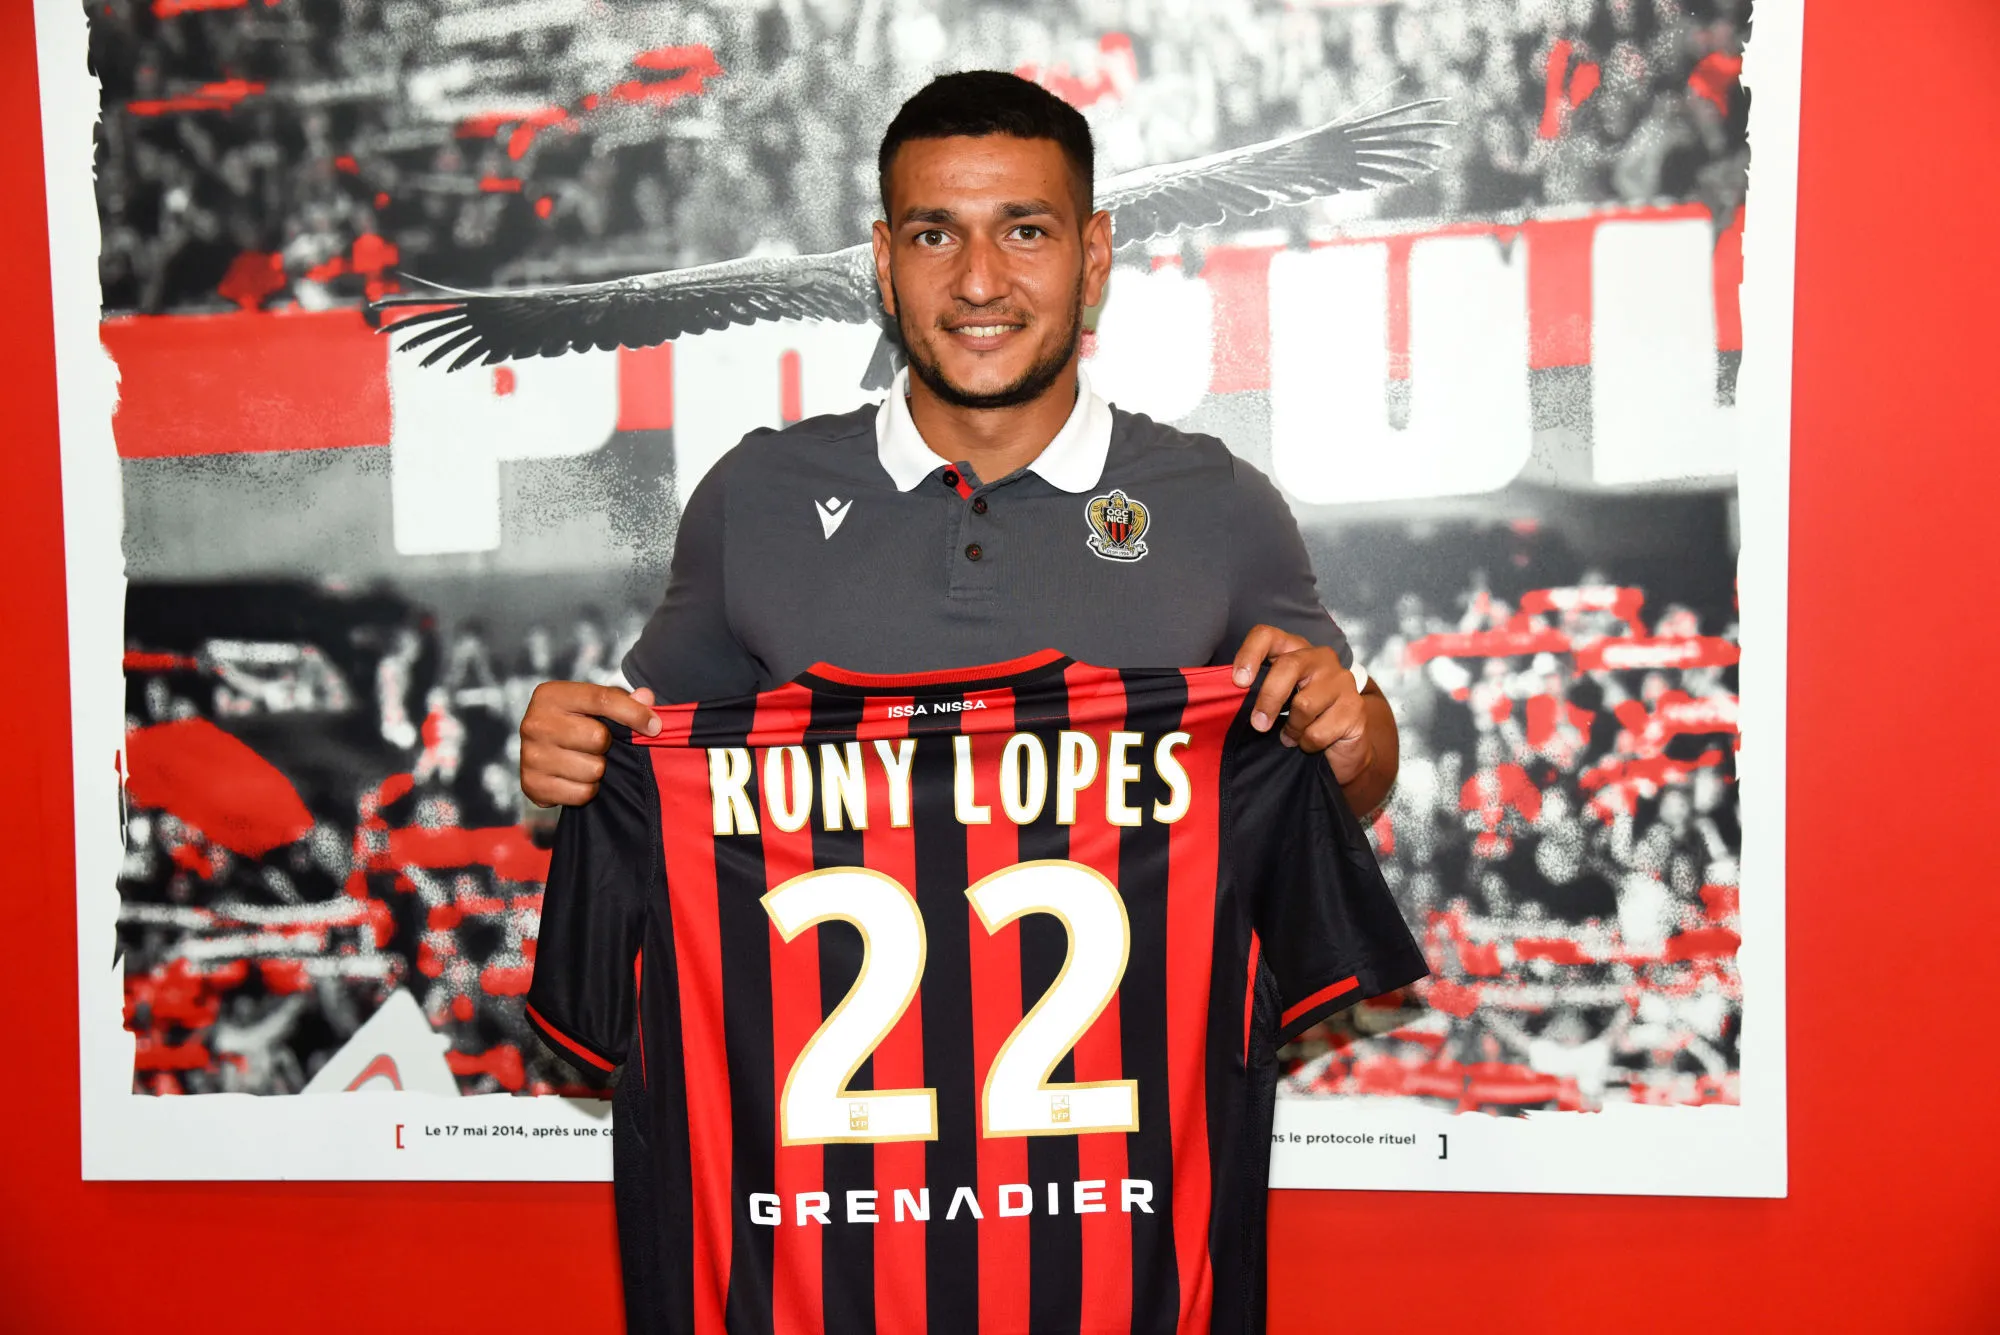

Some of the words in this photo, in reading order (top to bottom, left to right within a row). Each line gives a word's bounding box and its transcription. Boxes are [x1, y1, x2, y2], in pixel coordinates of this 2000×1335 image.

[1106, 508, 1129, 517] OGC
[1106, 516, 1129, 525] NICE
[888, 704, 928, 718] ISSA
[933, 699, 988, 714] NISSA
[707, 738, 918, 836] RONY
[952, 730, 1193, 827] LOPES
[759, 858, 1140, 1147] 22
[425, 1125, 442, 1136] Le
[445, 1125, 459, 1136] 17
[463, 1125, 488, 1137] mai
[491, 1125, 528, 1139] 2014,
[532, 1125, 569, 1140] après
[573, 1128, 598, 1137] une
[1289, 1132, 1302, 1143] le
[1306, 1132, 1375, 1146] protocole
[1379, 1132, 1417, 1145] rituel
[749, 1178, 1155, 1227] GRENADIER
